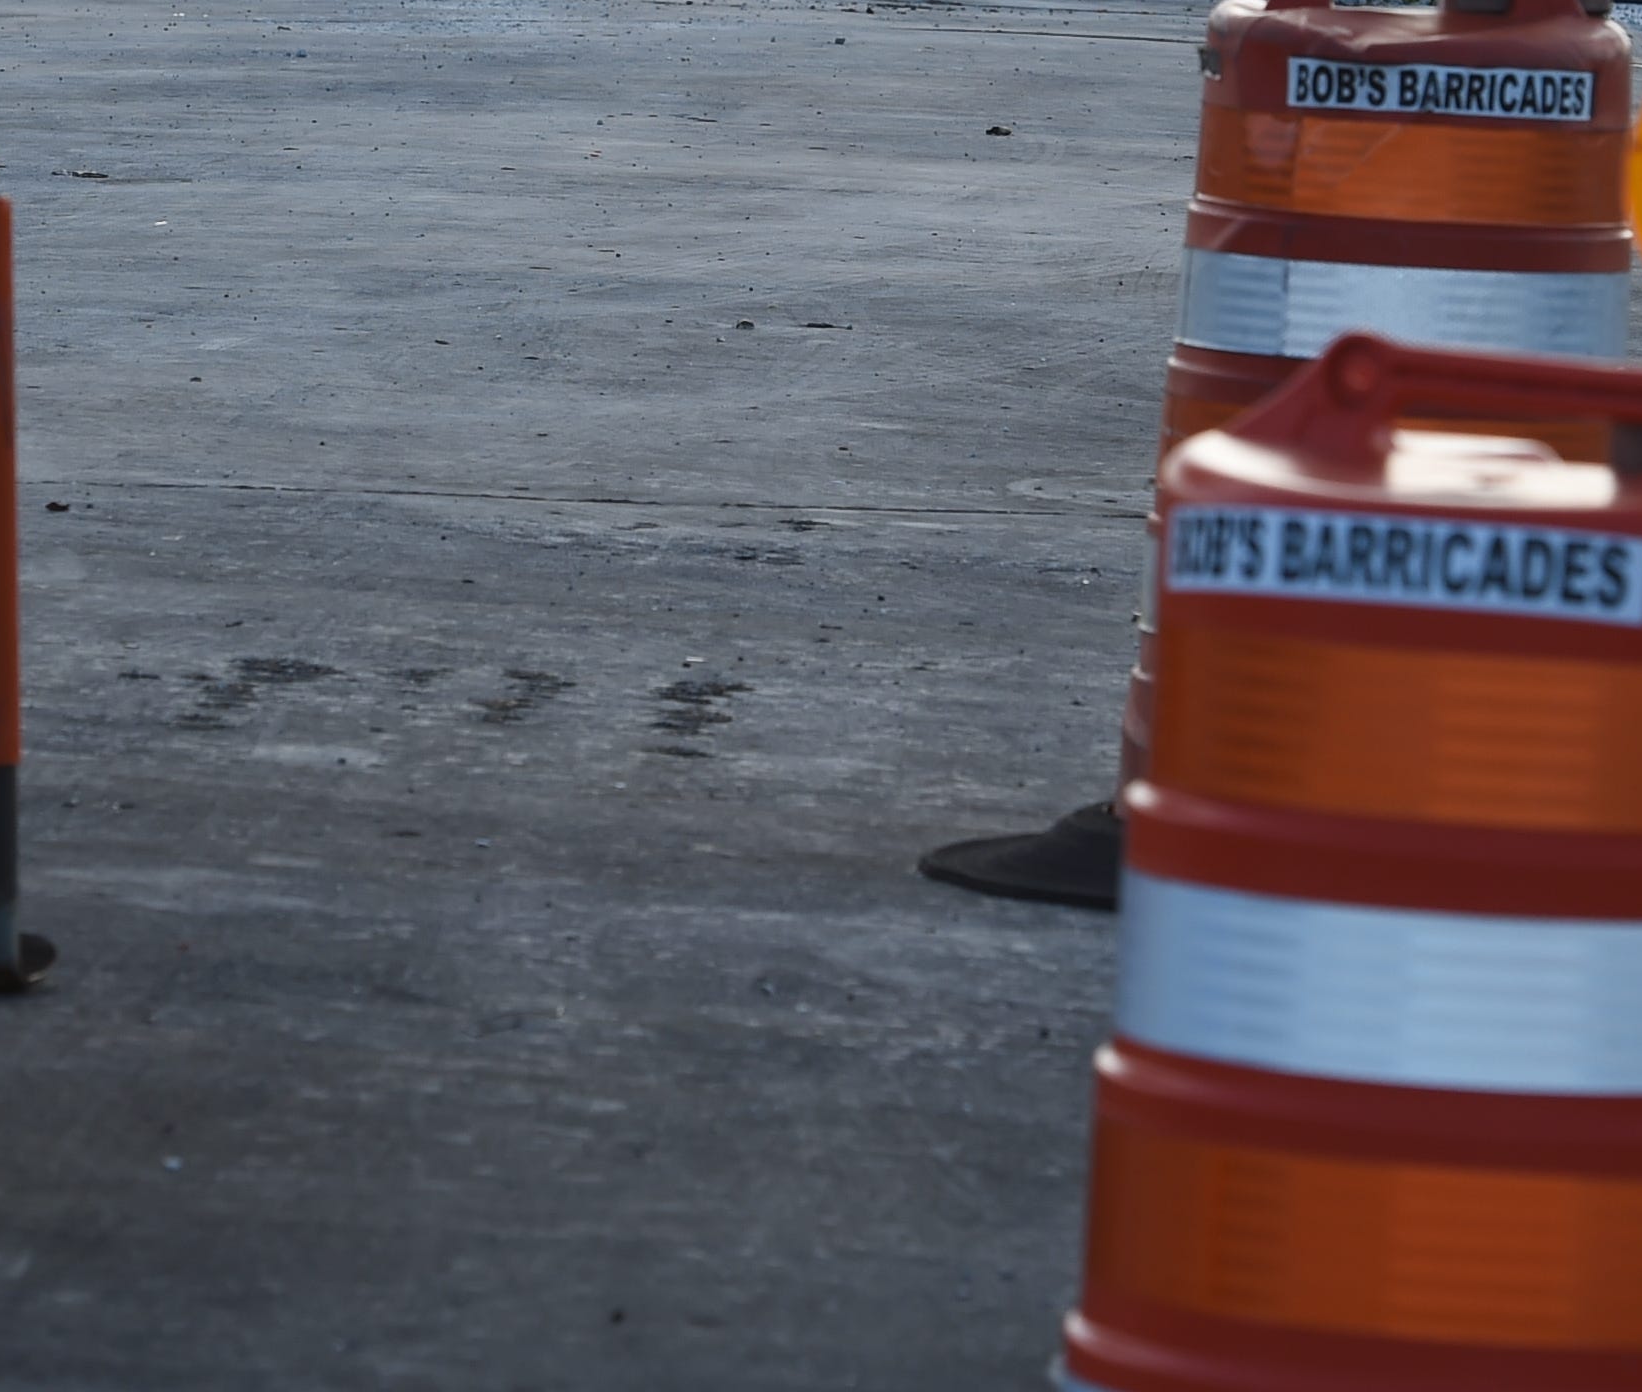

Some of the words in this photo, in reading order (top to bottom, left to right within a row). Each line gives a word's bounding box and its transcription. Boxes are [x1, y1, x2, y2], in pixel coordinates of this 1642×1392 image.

[1295, 64, 1387, 107] BOB'S
[1398, 69, 1587, 116] BARRICADES
[1280, 518, 1631, 609] BARRICADES
